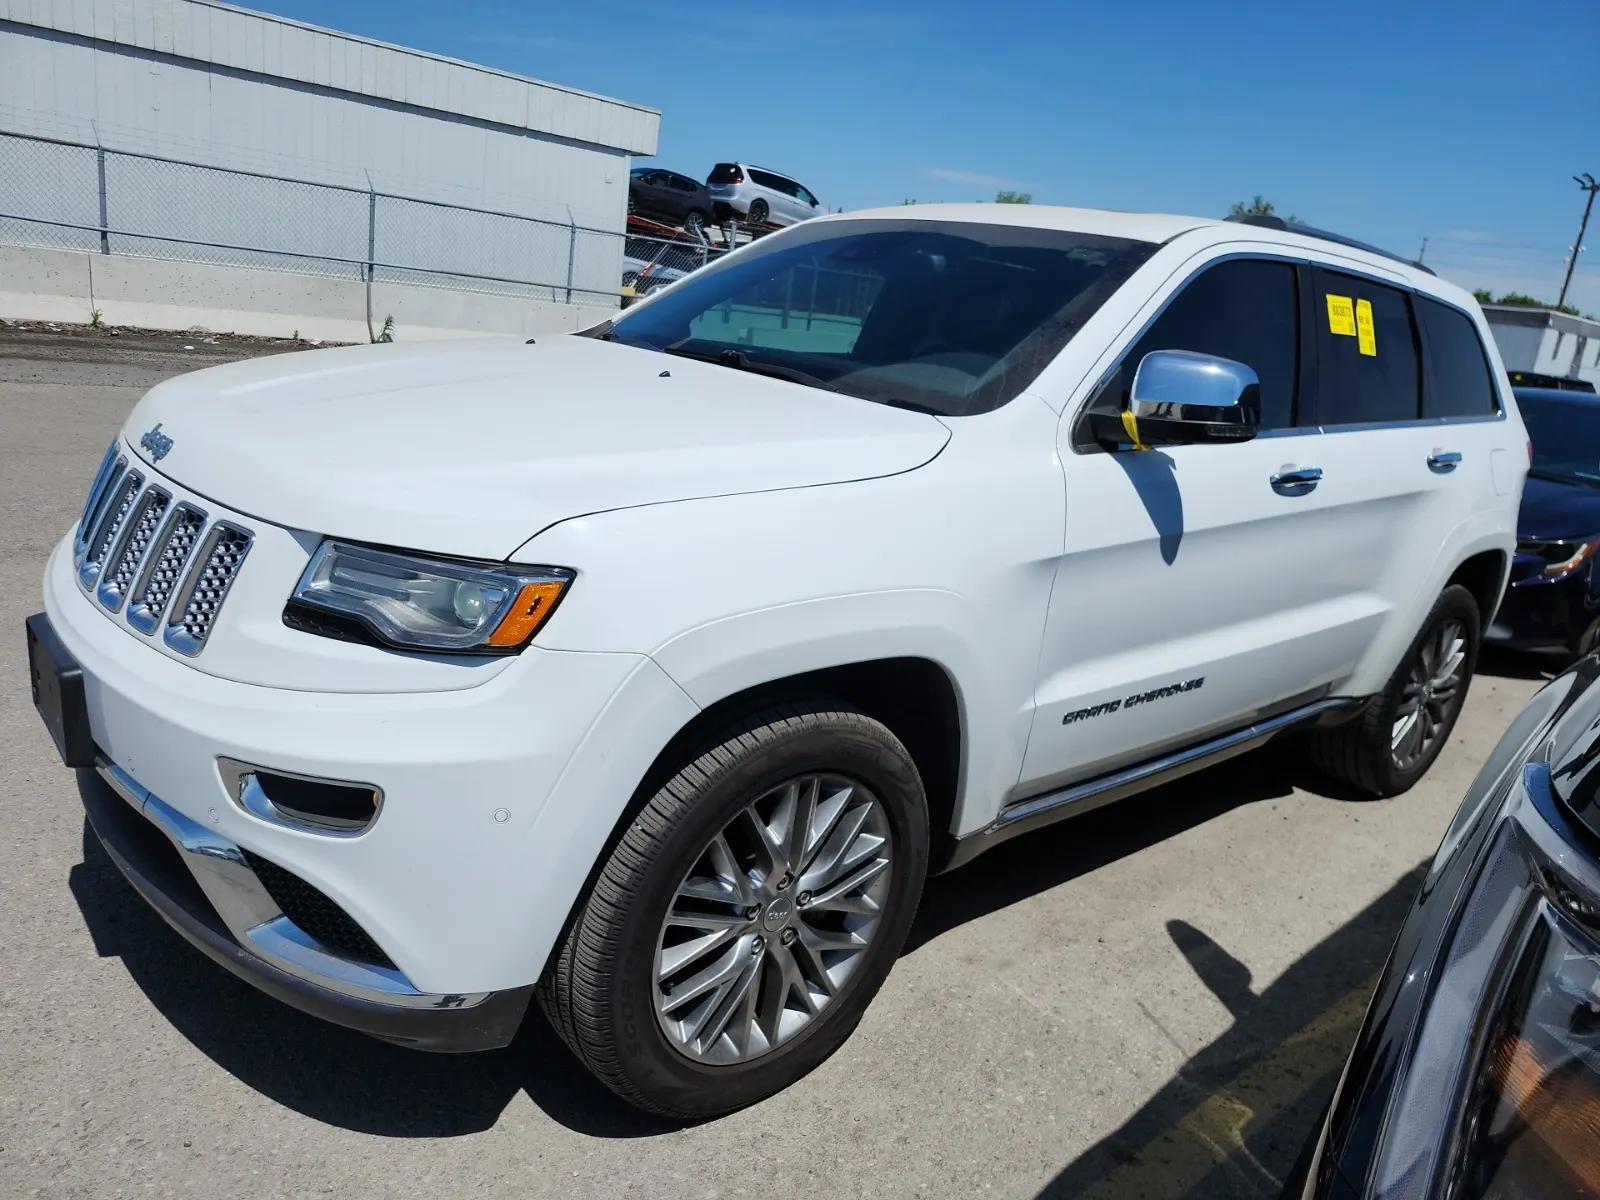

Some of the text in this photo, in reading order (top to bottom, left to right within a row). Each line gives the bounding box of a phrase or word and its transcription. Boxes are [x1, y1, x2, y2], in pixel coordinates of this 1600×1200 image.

[140, 422, 174, 464] Jeep
[1062, 676, 1206, 725] GRAND CHEROKEE
